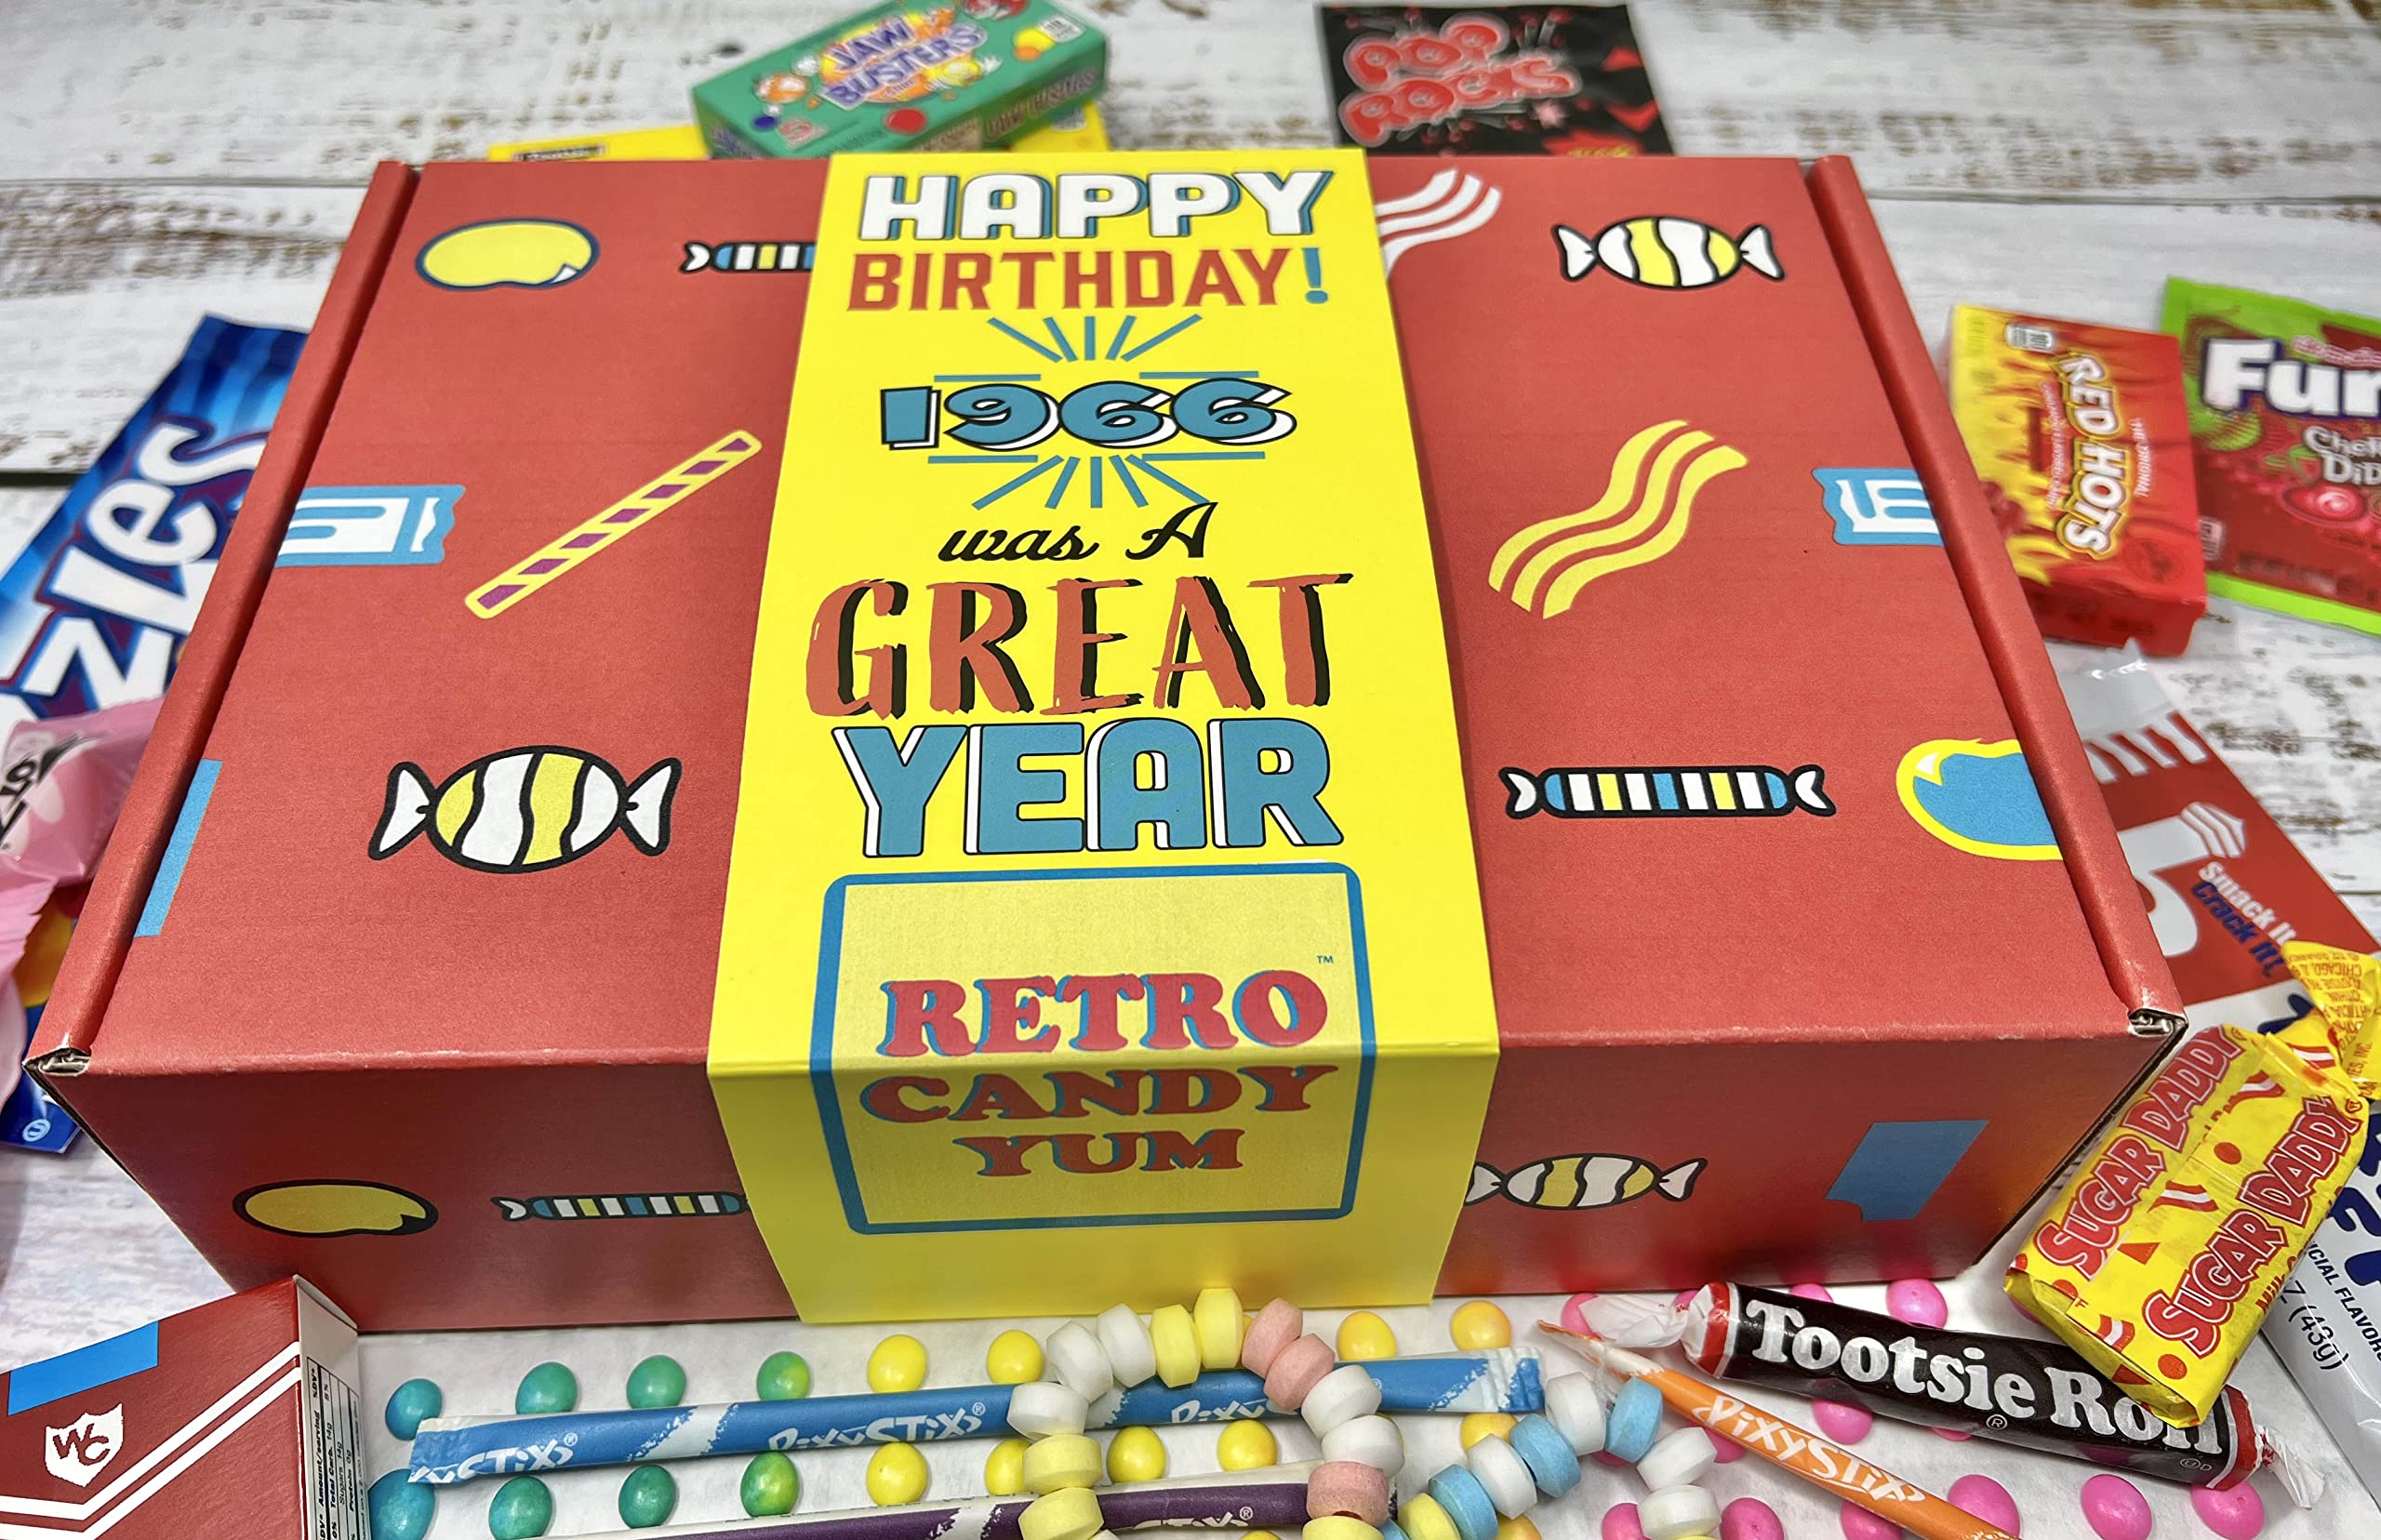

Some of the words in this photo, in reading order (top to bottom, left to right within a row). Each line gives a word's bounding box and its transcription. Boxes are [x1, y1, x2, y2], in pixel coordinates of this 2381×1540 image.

[824, 24, 985, 106] BUSTERS
[830, 15, 915, 71] JAW
[1349, 17, 1504, 88] POP
[1342, 53, 1580, 146] ROCKS
[858, 169, 1334, 242] HAPPY
[846, 246, 1329, 312] BIRTHDAY!
[880, 378, 1297, 451] 1966
[2057, 353, 2121, 437] RED
[938, 521, 1099, 562] was
[1124, 501, 1218, 560] A
[2063, 443, 2126, 555] HOTS
[805, 573, 1354, 721] GREAT
[831, 717, 1345, 858] YEAR
[2193, 881, 2258, 944] Crack
[2198, 860, 2277, 931] Smack
[874, 969, 1328, 1057] RETRO
[859, 1064, 1339, 1123] CANDY
[951, 1127, 1246, 1177] YUM
[2036, 1134, 2167, 1281] SUGAR
[2121, 1025, 2245, 1153] DADDY
[2142, 1209, 2288, 1360] SUGAR
[2236, 1095, 2362, 1229] DADDY
[1746, 1298, 2036, 1420] Tootsie
[2288, 1305, 2349, 1371] (43g)
[53, 1422, 111, 1467] WC
[313, 1410, 326, 1507] Amount/serving
[338, 1467, 346, 1505] Sugars
[347, 1468, 355, 1512] Protein
